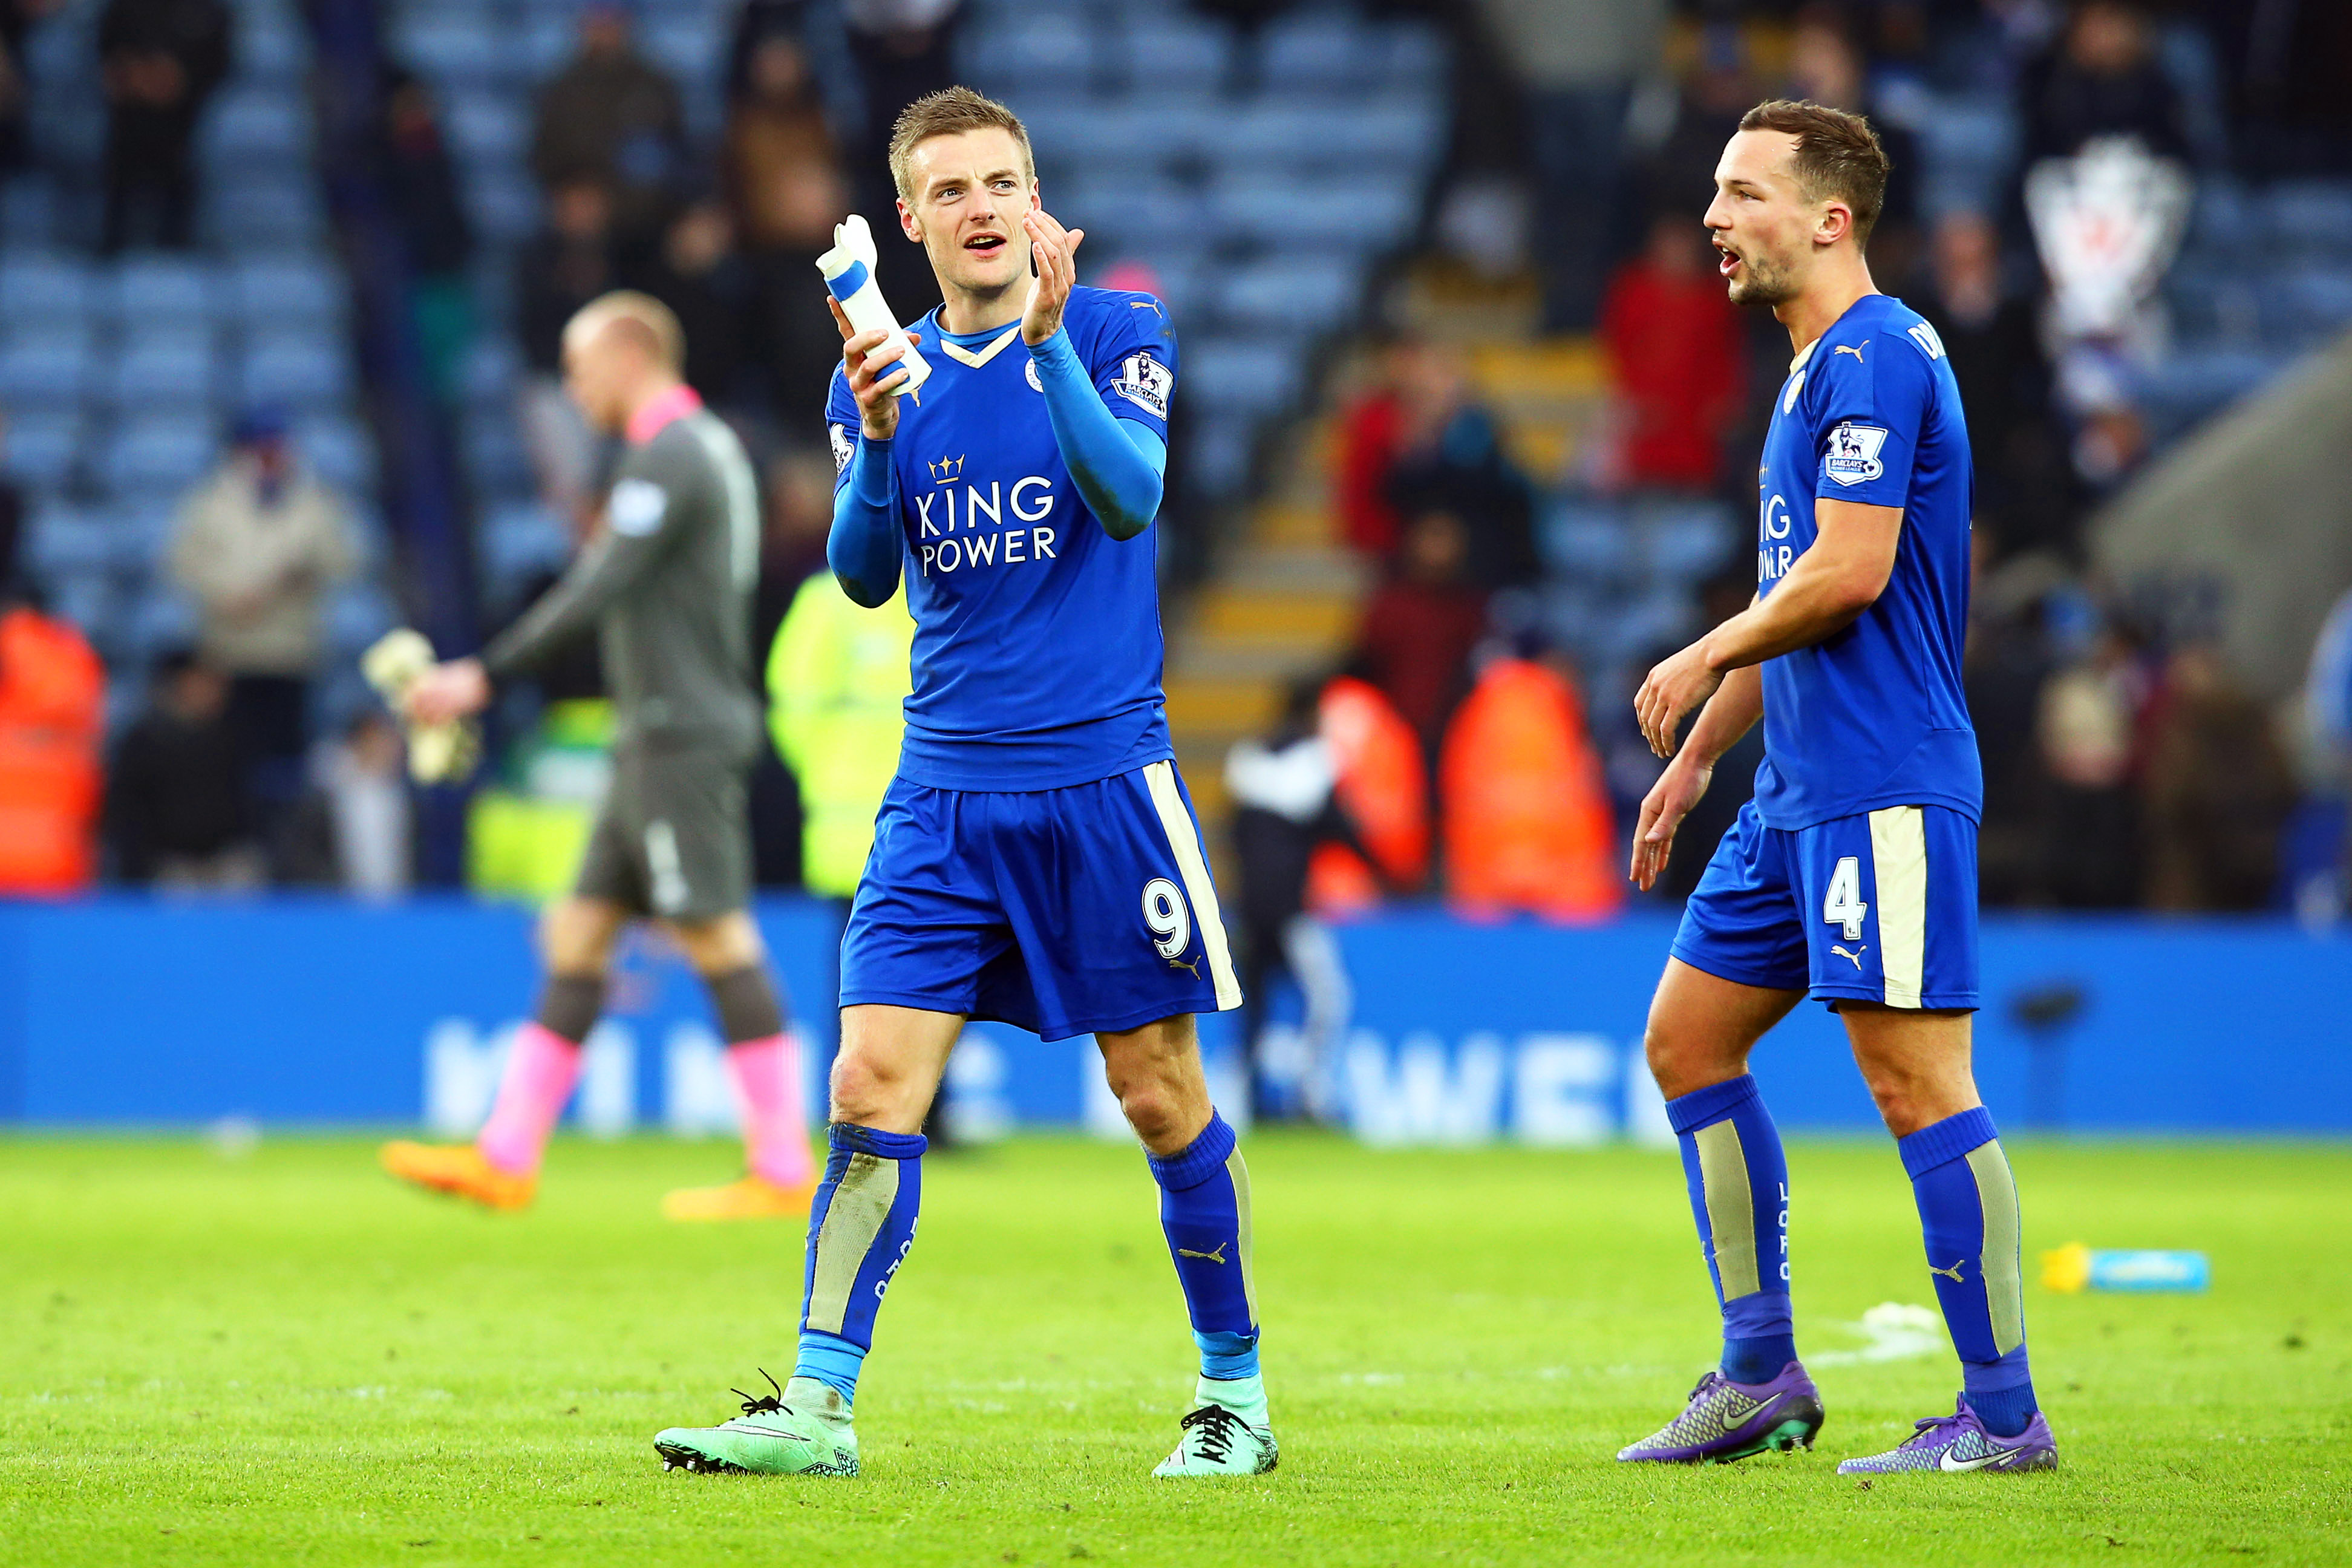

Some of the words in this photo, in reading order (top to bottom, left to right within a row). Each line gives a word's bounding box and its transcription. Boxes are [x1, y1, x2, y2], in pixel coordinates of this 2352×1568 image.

[1125, 384, 1160, 405] BARCLAYS
[1831, 459, 1864, 468] BARCLAYS
[915, 476, 1054, 539] KING
[920, 527, 1057, 577] POWER
[1142, 877, 1191, 959] 9
[1823, 857, 1867, 940] 4
